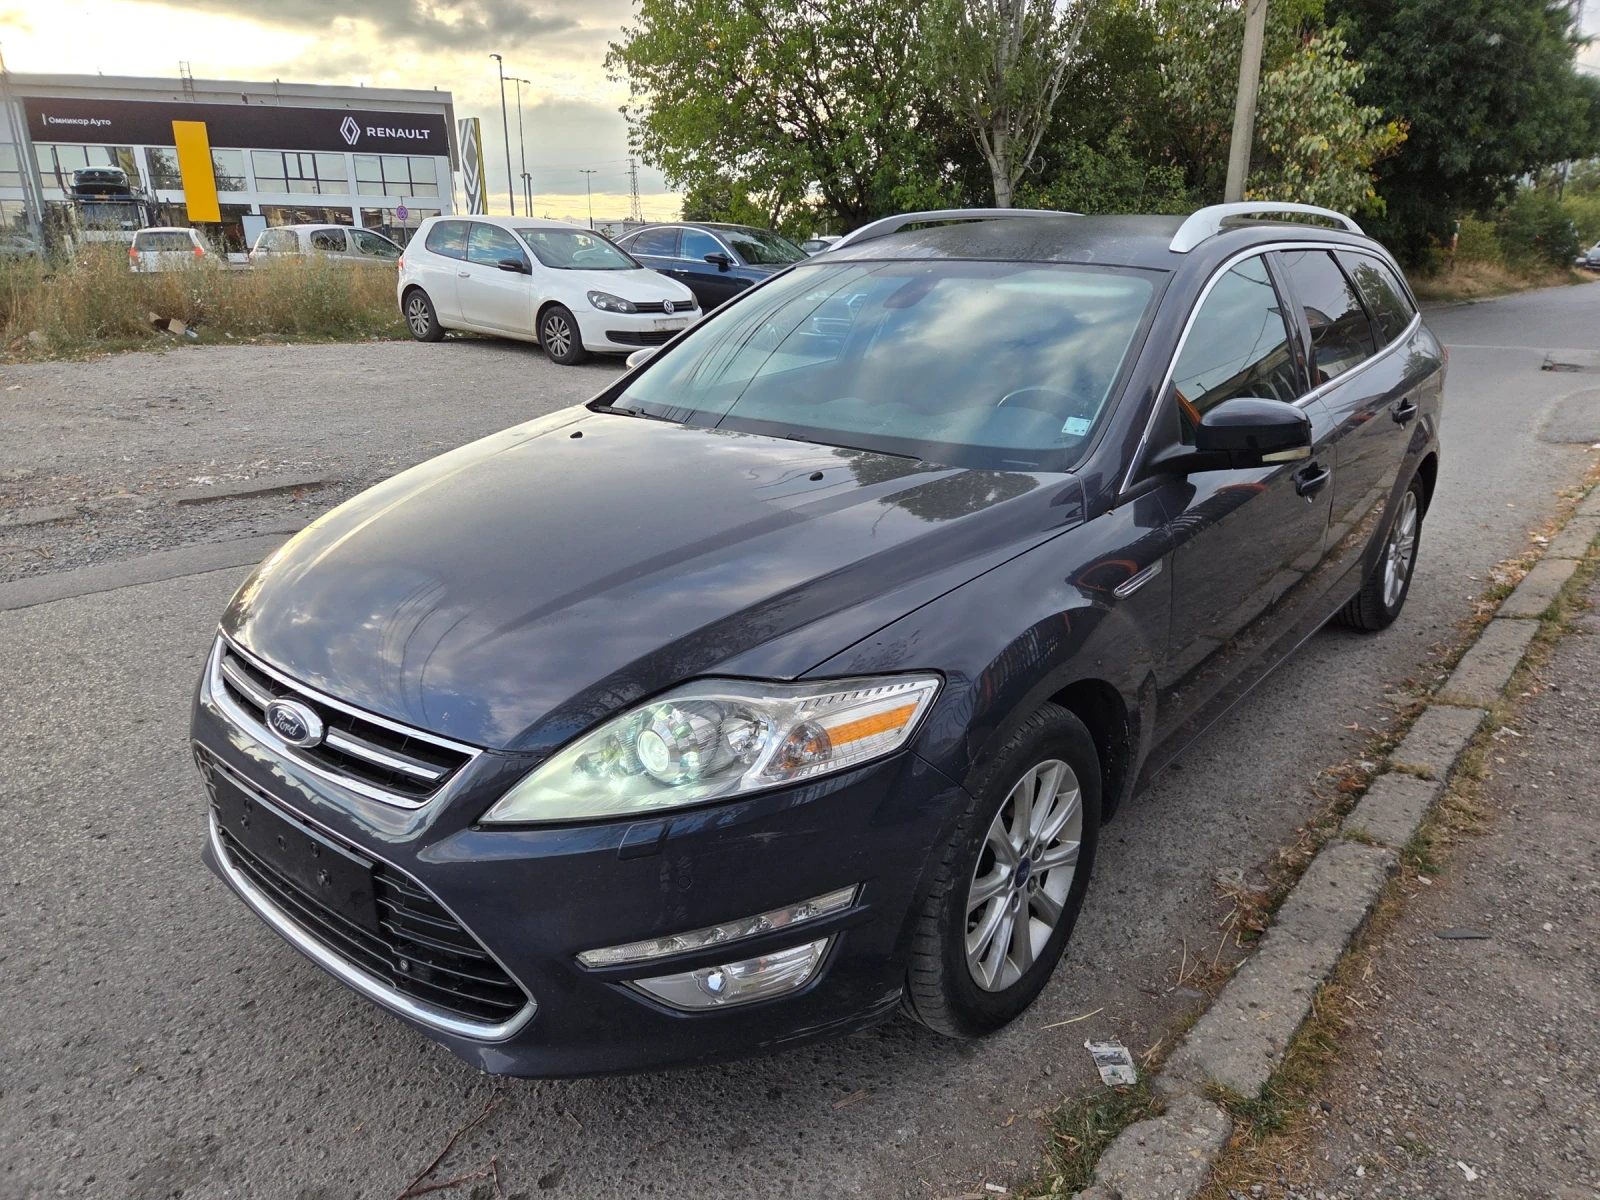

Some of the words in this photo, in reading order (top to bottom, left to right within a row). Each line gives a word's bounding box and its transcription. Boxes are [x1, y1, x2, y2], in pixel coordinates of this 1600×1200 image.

[48, 116, 89, 126] Омникар
[90, 118, 111, 126] Ауто
[366, 127, 430, 139] RENAULT
[273, 710, 300, 736] Ford
